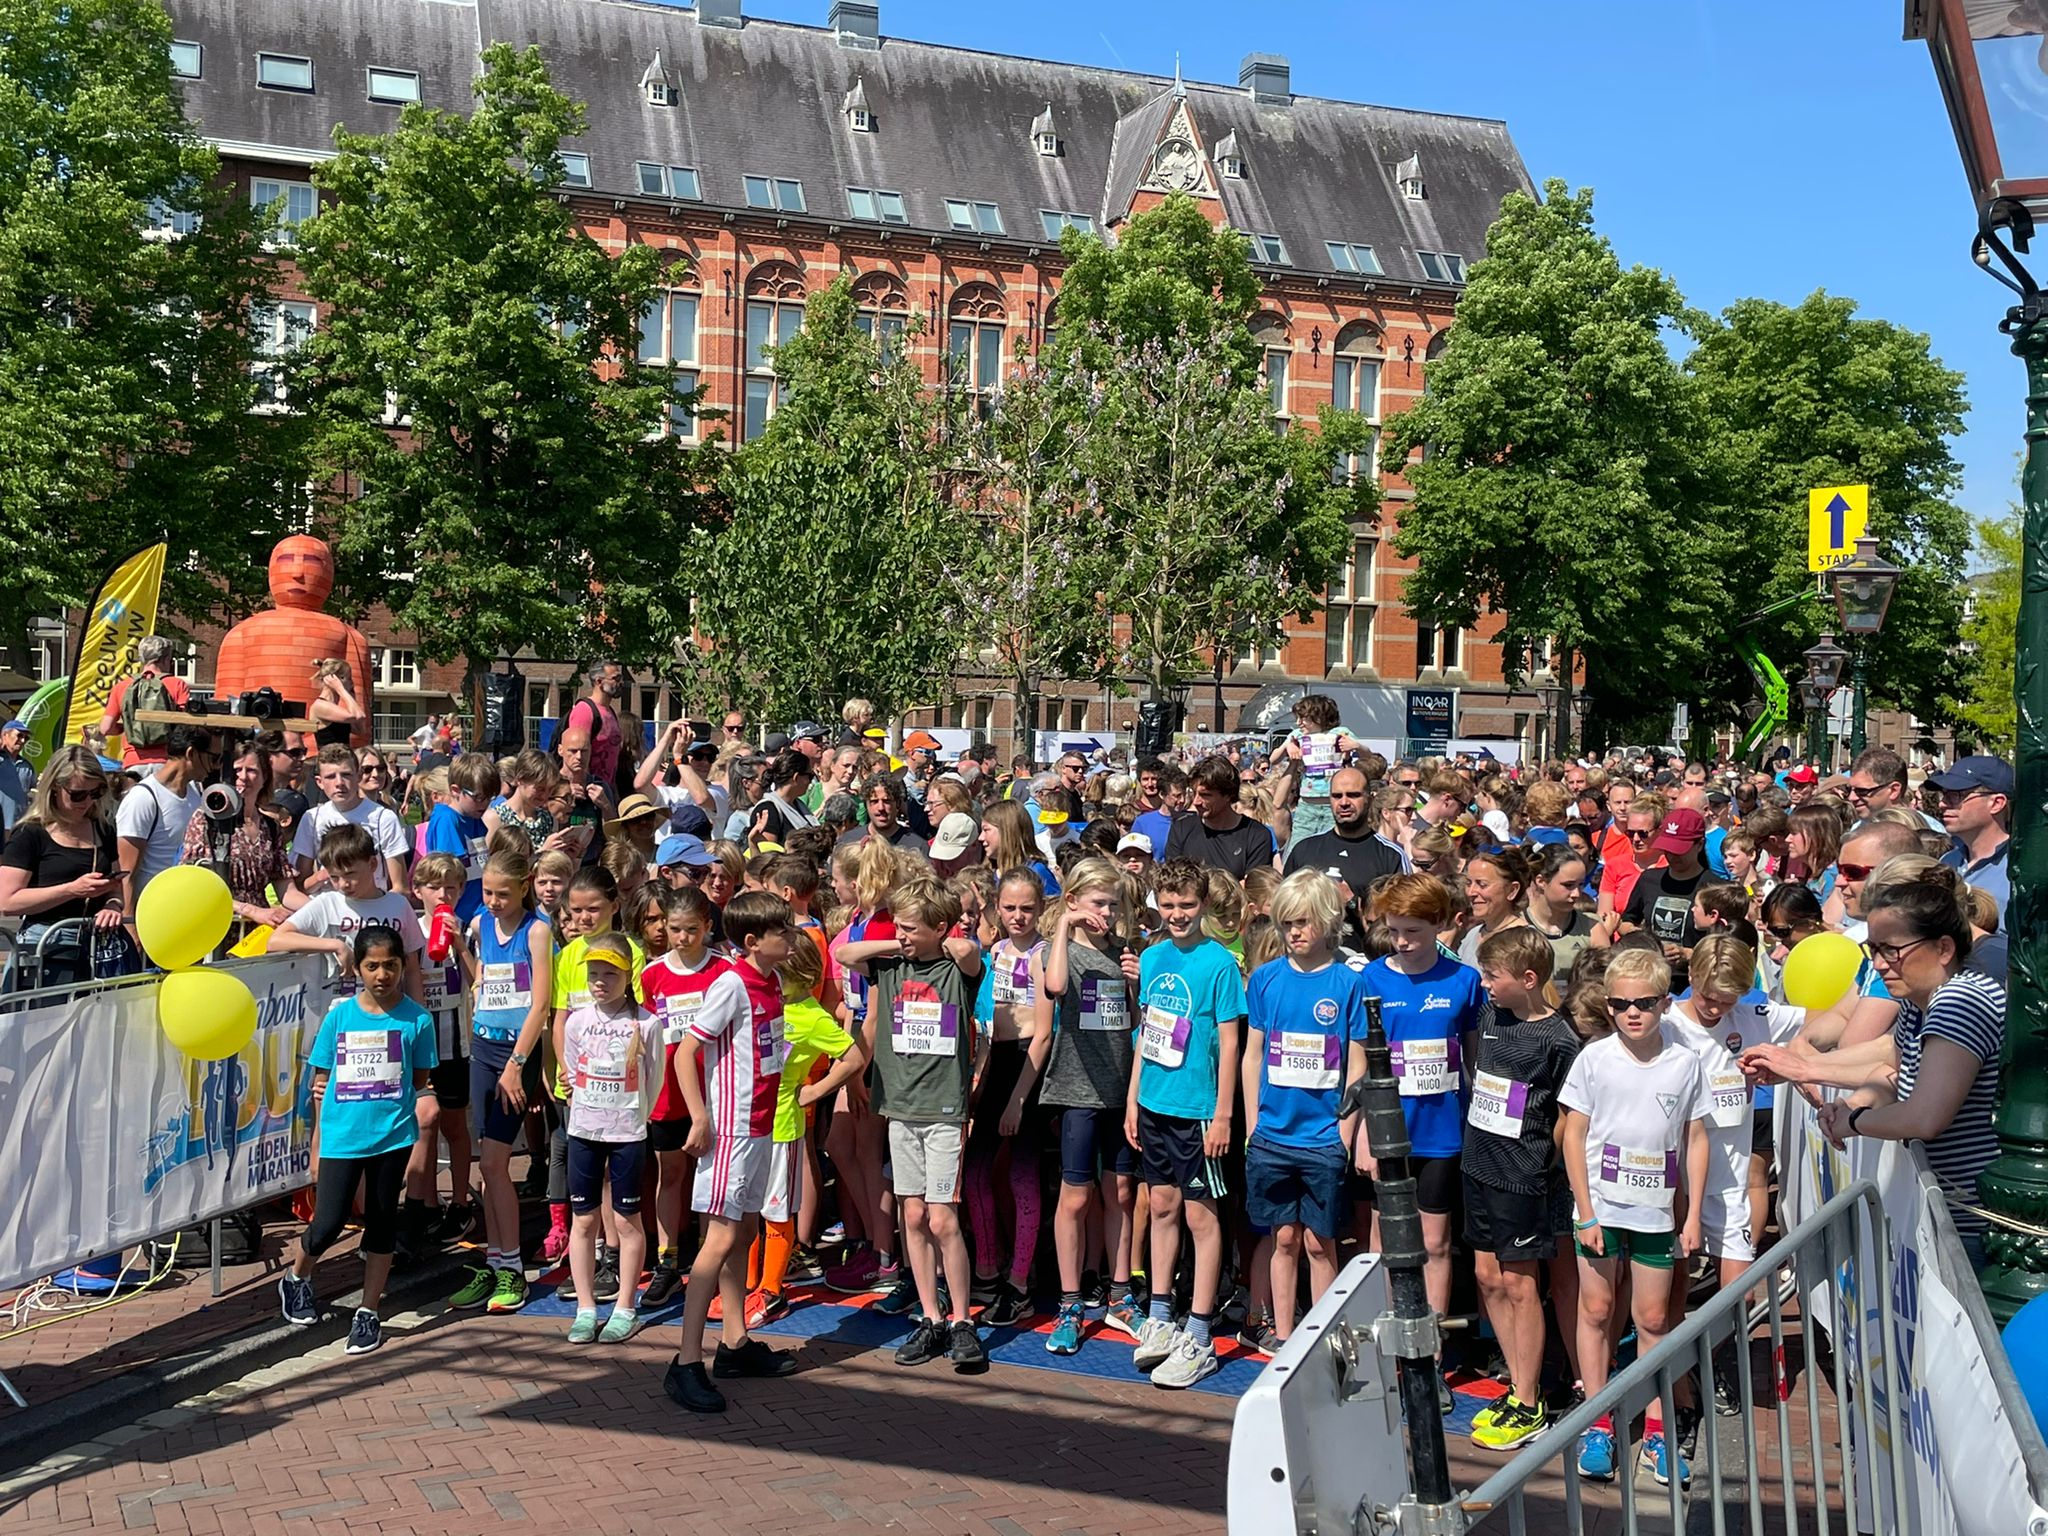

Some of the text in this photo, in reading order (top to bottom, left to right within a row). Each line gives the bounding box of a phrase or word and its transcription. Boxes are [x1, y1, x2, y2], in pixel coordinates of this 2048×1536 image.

[1818, 553, 1856, 566] STAR
[84, 624, 120, 708] Zeeuw
[1412, 695, 1449, 710] INQAR
[942, 831, 949, 841] G
[485, 983, 511, 995] 15532
[488, 996, 508, 1007] ANNA
[672, 1014, 697, 1027] 1574
[906, 1025, 935, 1036] 15640
[908, 1038, 931, 1050] TOBIN
[1289, 1039, 1323, 1049] CORPUS
[351, 1053, 383, 1065] 15722
[1287, 1057, 1319, 1070] 15866
[357, 1066, 377, 1078] SIYA
[1411, 1063, 1443, 1077] 15507
[590, 1080, 620, 1093] 17819
[1417, 1078, 1441, 1091] HUGO
[1474, 1095, 1501, 1114] 16003
[1713, 1093, 1744, 1108] 15837
[247, 1134, 289, 1167] LEIDEN
[1628, 1154, 1664, 1166] CORPUS
[247, 1150, 311, 1190] MARATHO
[1624, 1173, 1660, 1189] 15825
